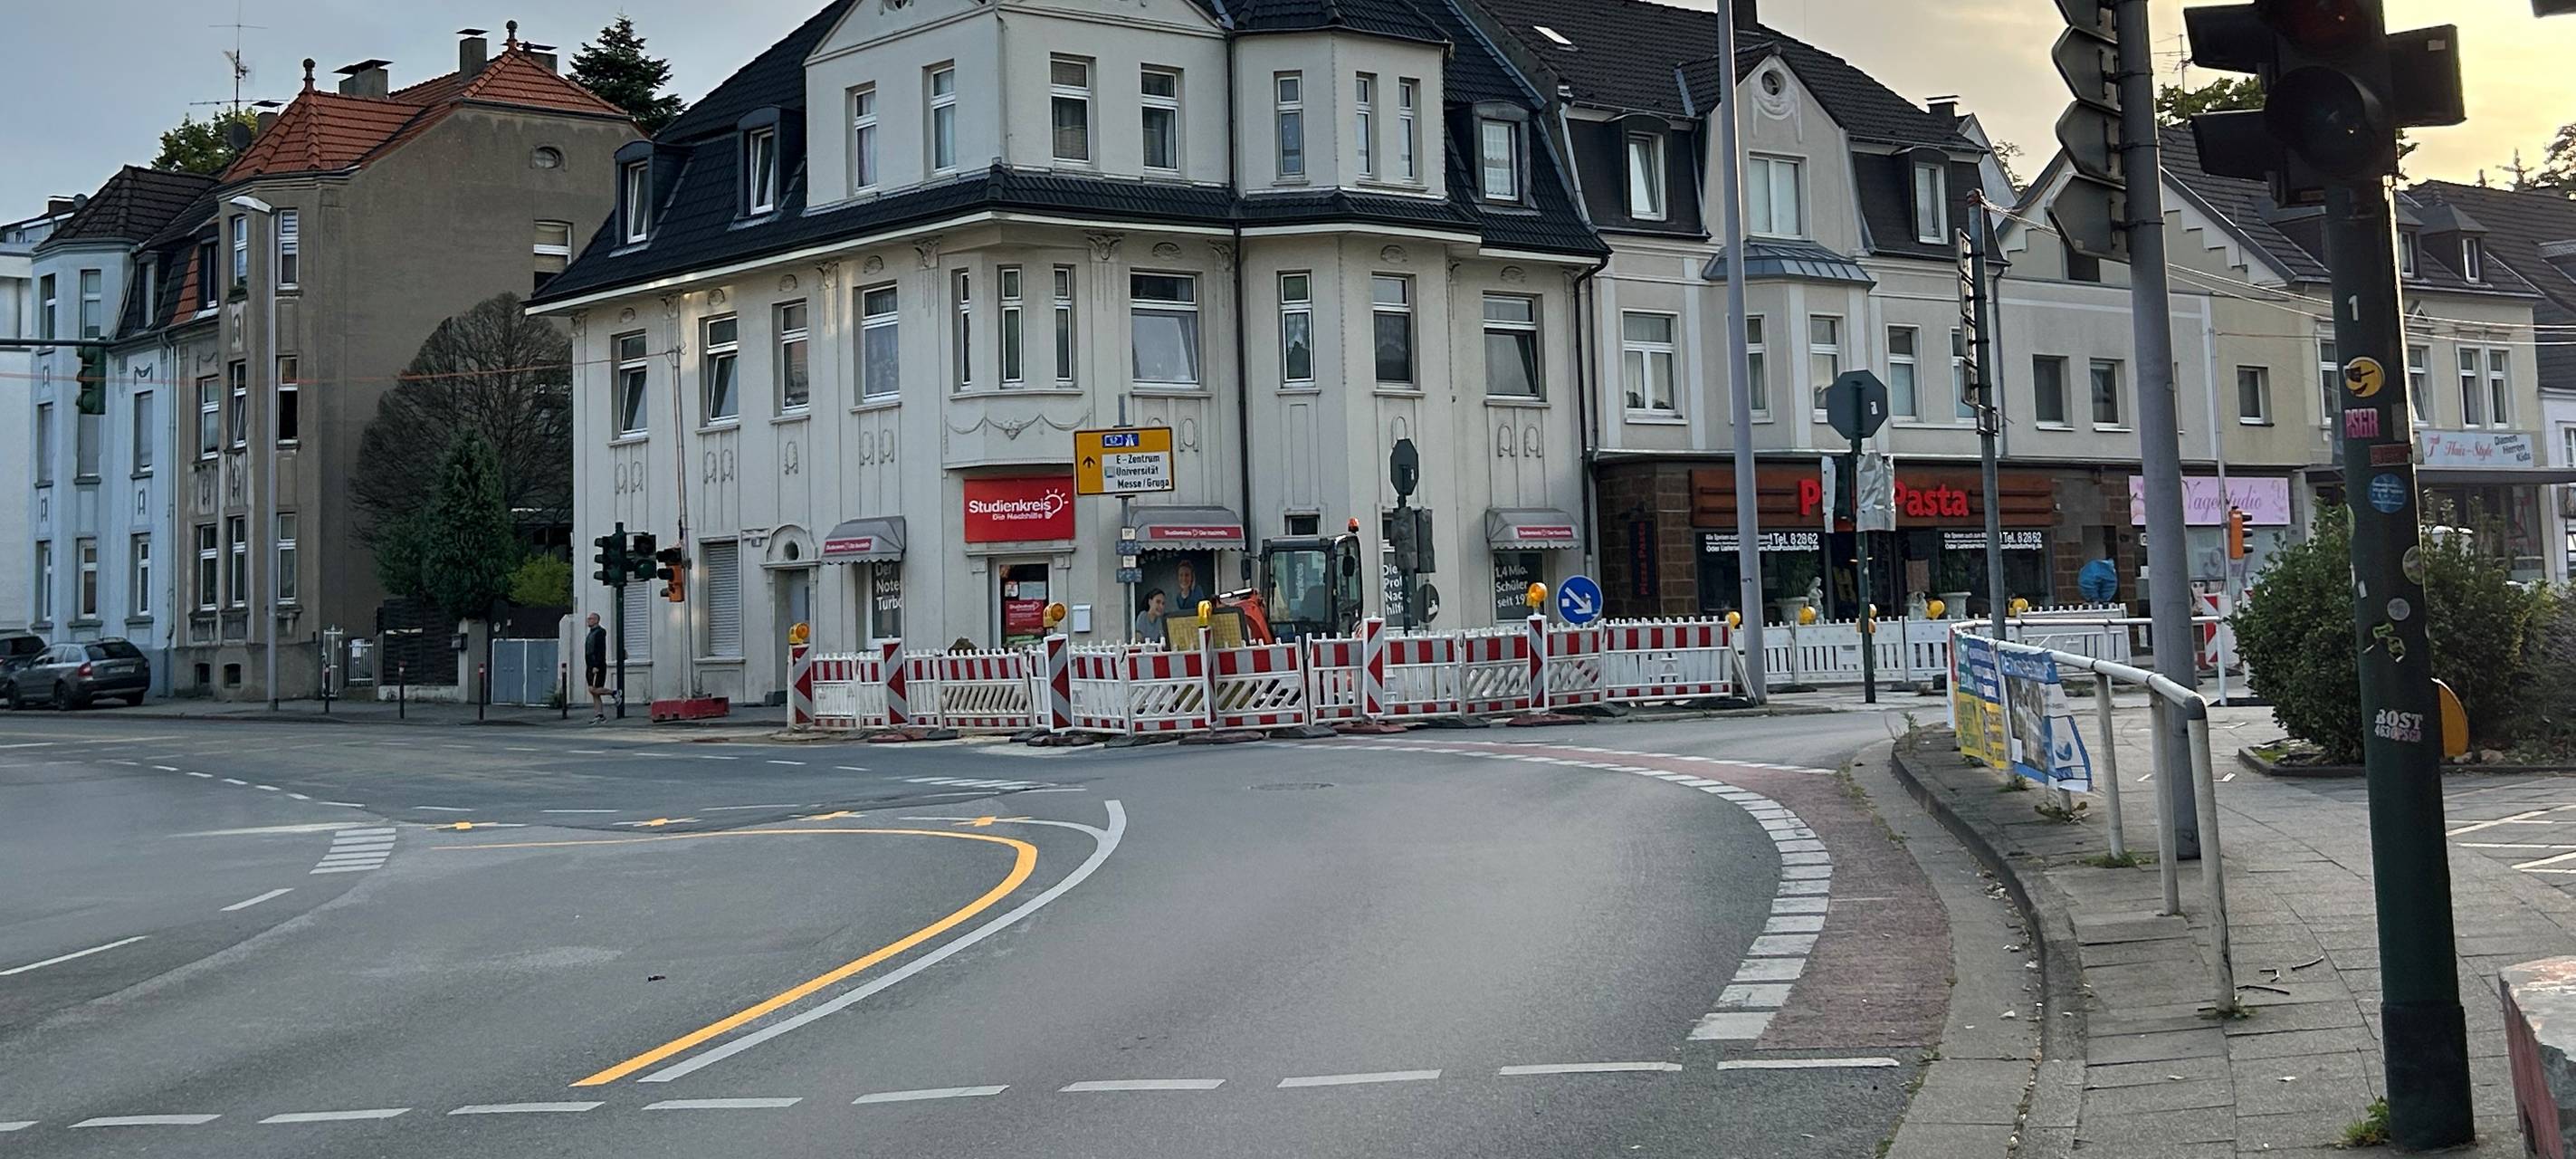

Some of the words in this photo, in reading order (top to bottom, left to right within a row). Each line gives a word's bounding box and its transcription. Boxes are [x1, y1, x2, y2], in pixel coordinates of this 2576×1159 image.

[2348, 294, 2359, 321] 1
[2494, 435, 2517, 445] Damen
[2502, 444, 2525, 455] Herren
[2516, 452, 2531, 462] Kids
[1116, 465, 1159, 476] Universität
[968, 498, 1051, 514] Studienkreis
[992, 512, 1006, 521] Die
[1007, 512, 1043, 521] Nachhilfe
[1773, 533, 1789, 545] Tel.
[2002, 532, 2017, 543] Tel.
[875, 562, 892, 576] Der
[1382, 565, 1398, 575] Die
[1495, 580, 1528, 593] Schüler
[1497, 596, 1513, 608] seit
